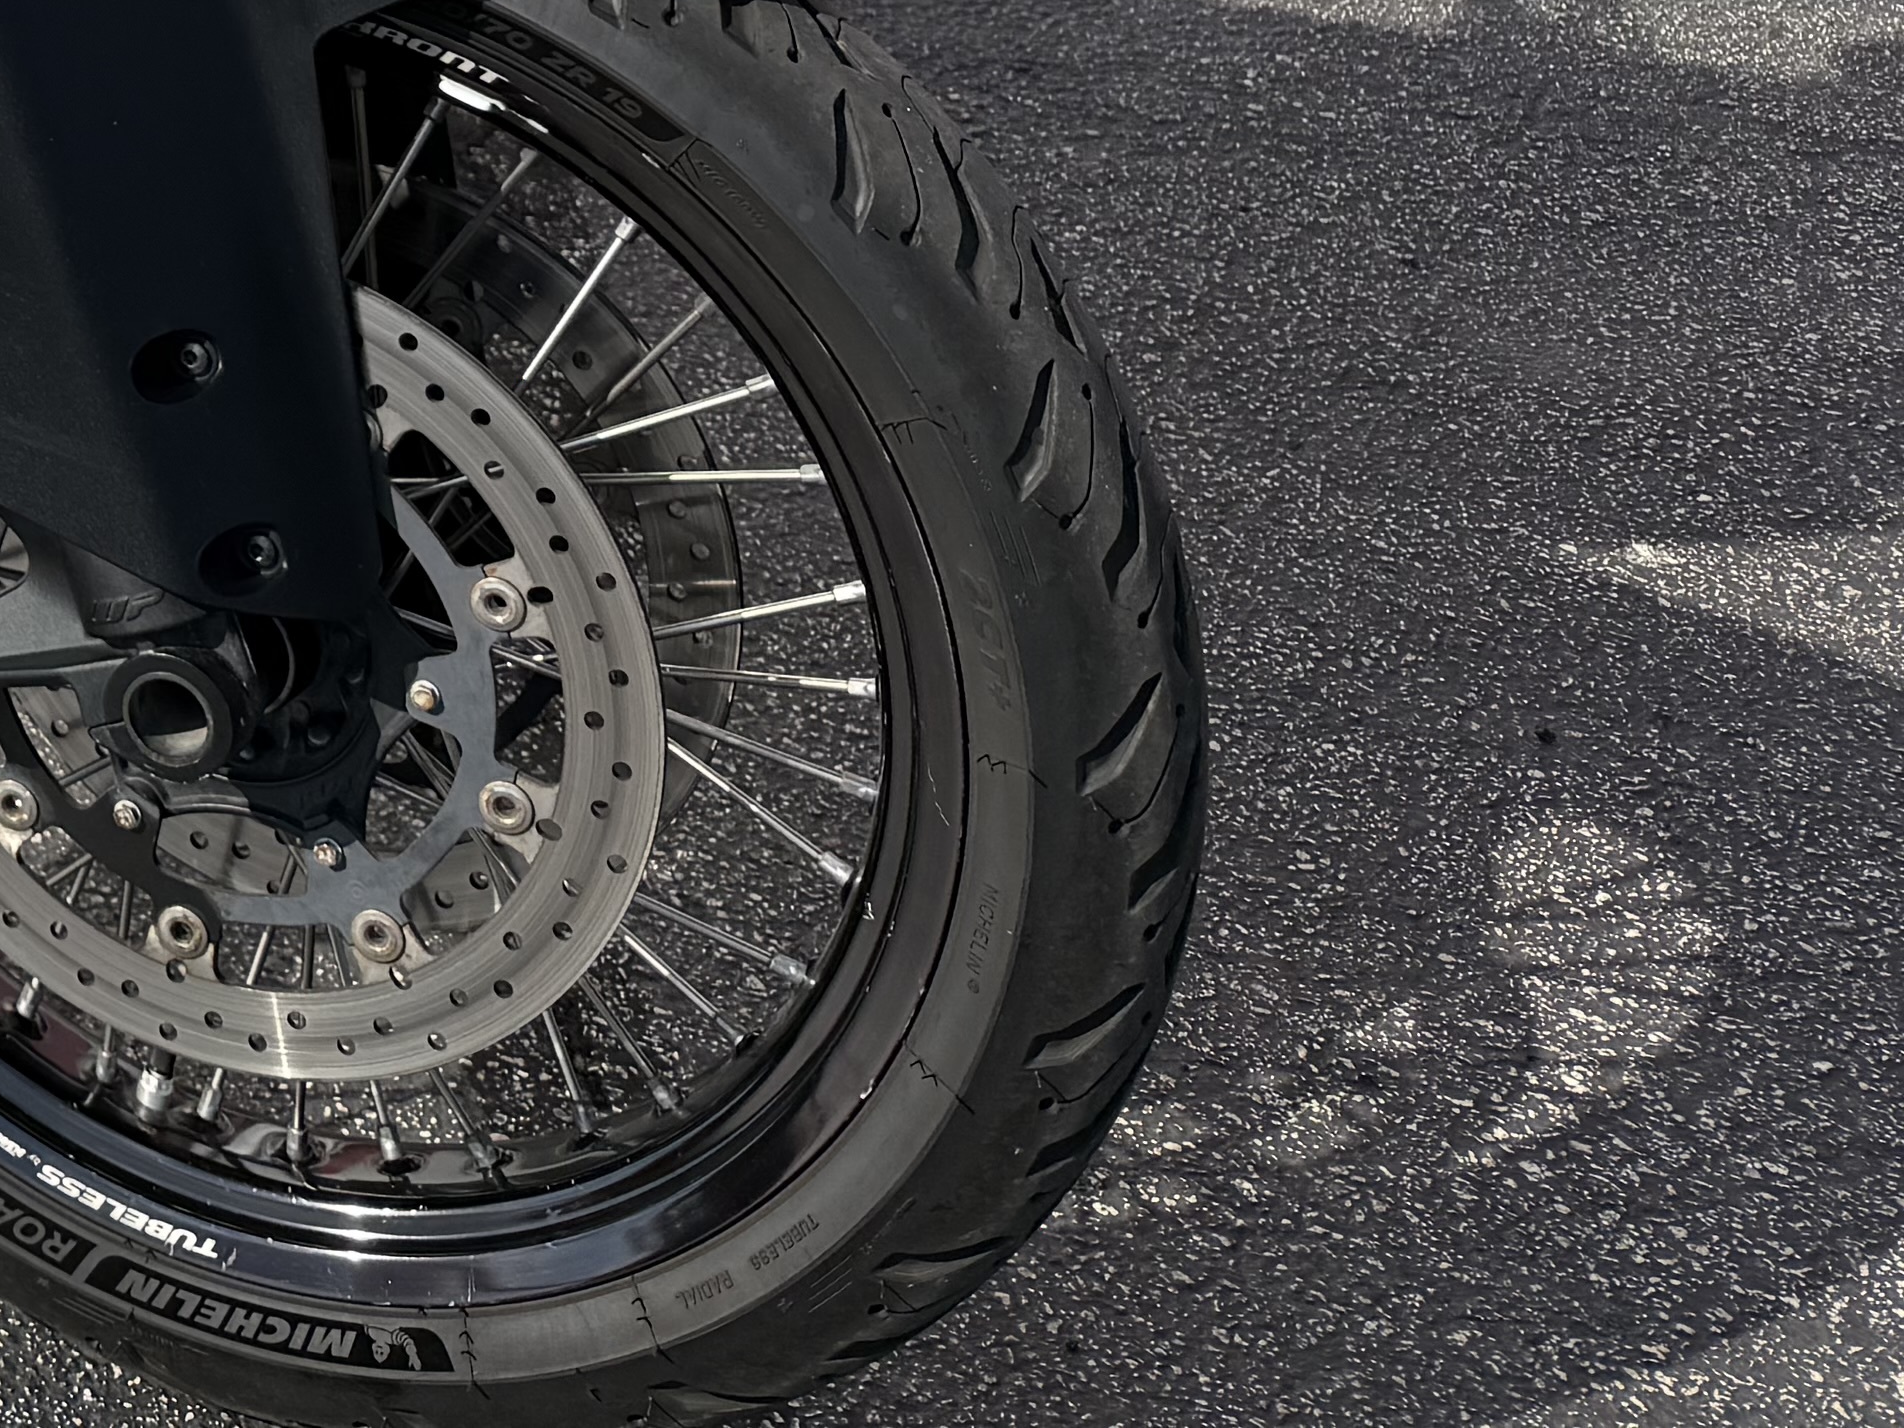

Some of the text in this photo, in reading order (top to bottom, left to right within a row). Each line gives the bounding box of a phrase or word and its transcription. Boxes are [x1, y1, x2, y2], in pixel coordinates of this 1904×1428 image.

[539, 50, 598, 88] ZR
[603, 87, 643, 120] 19
[965, 882, 999, 976] MICHELIN
[36, 1164, 218, 1259] TUBELESS
[114, 1265, 358, 1359] MICHELIN
